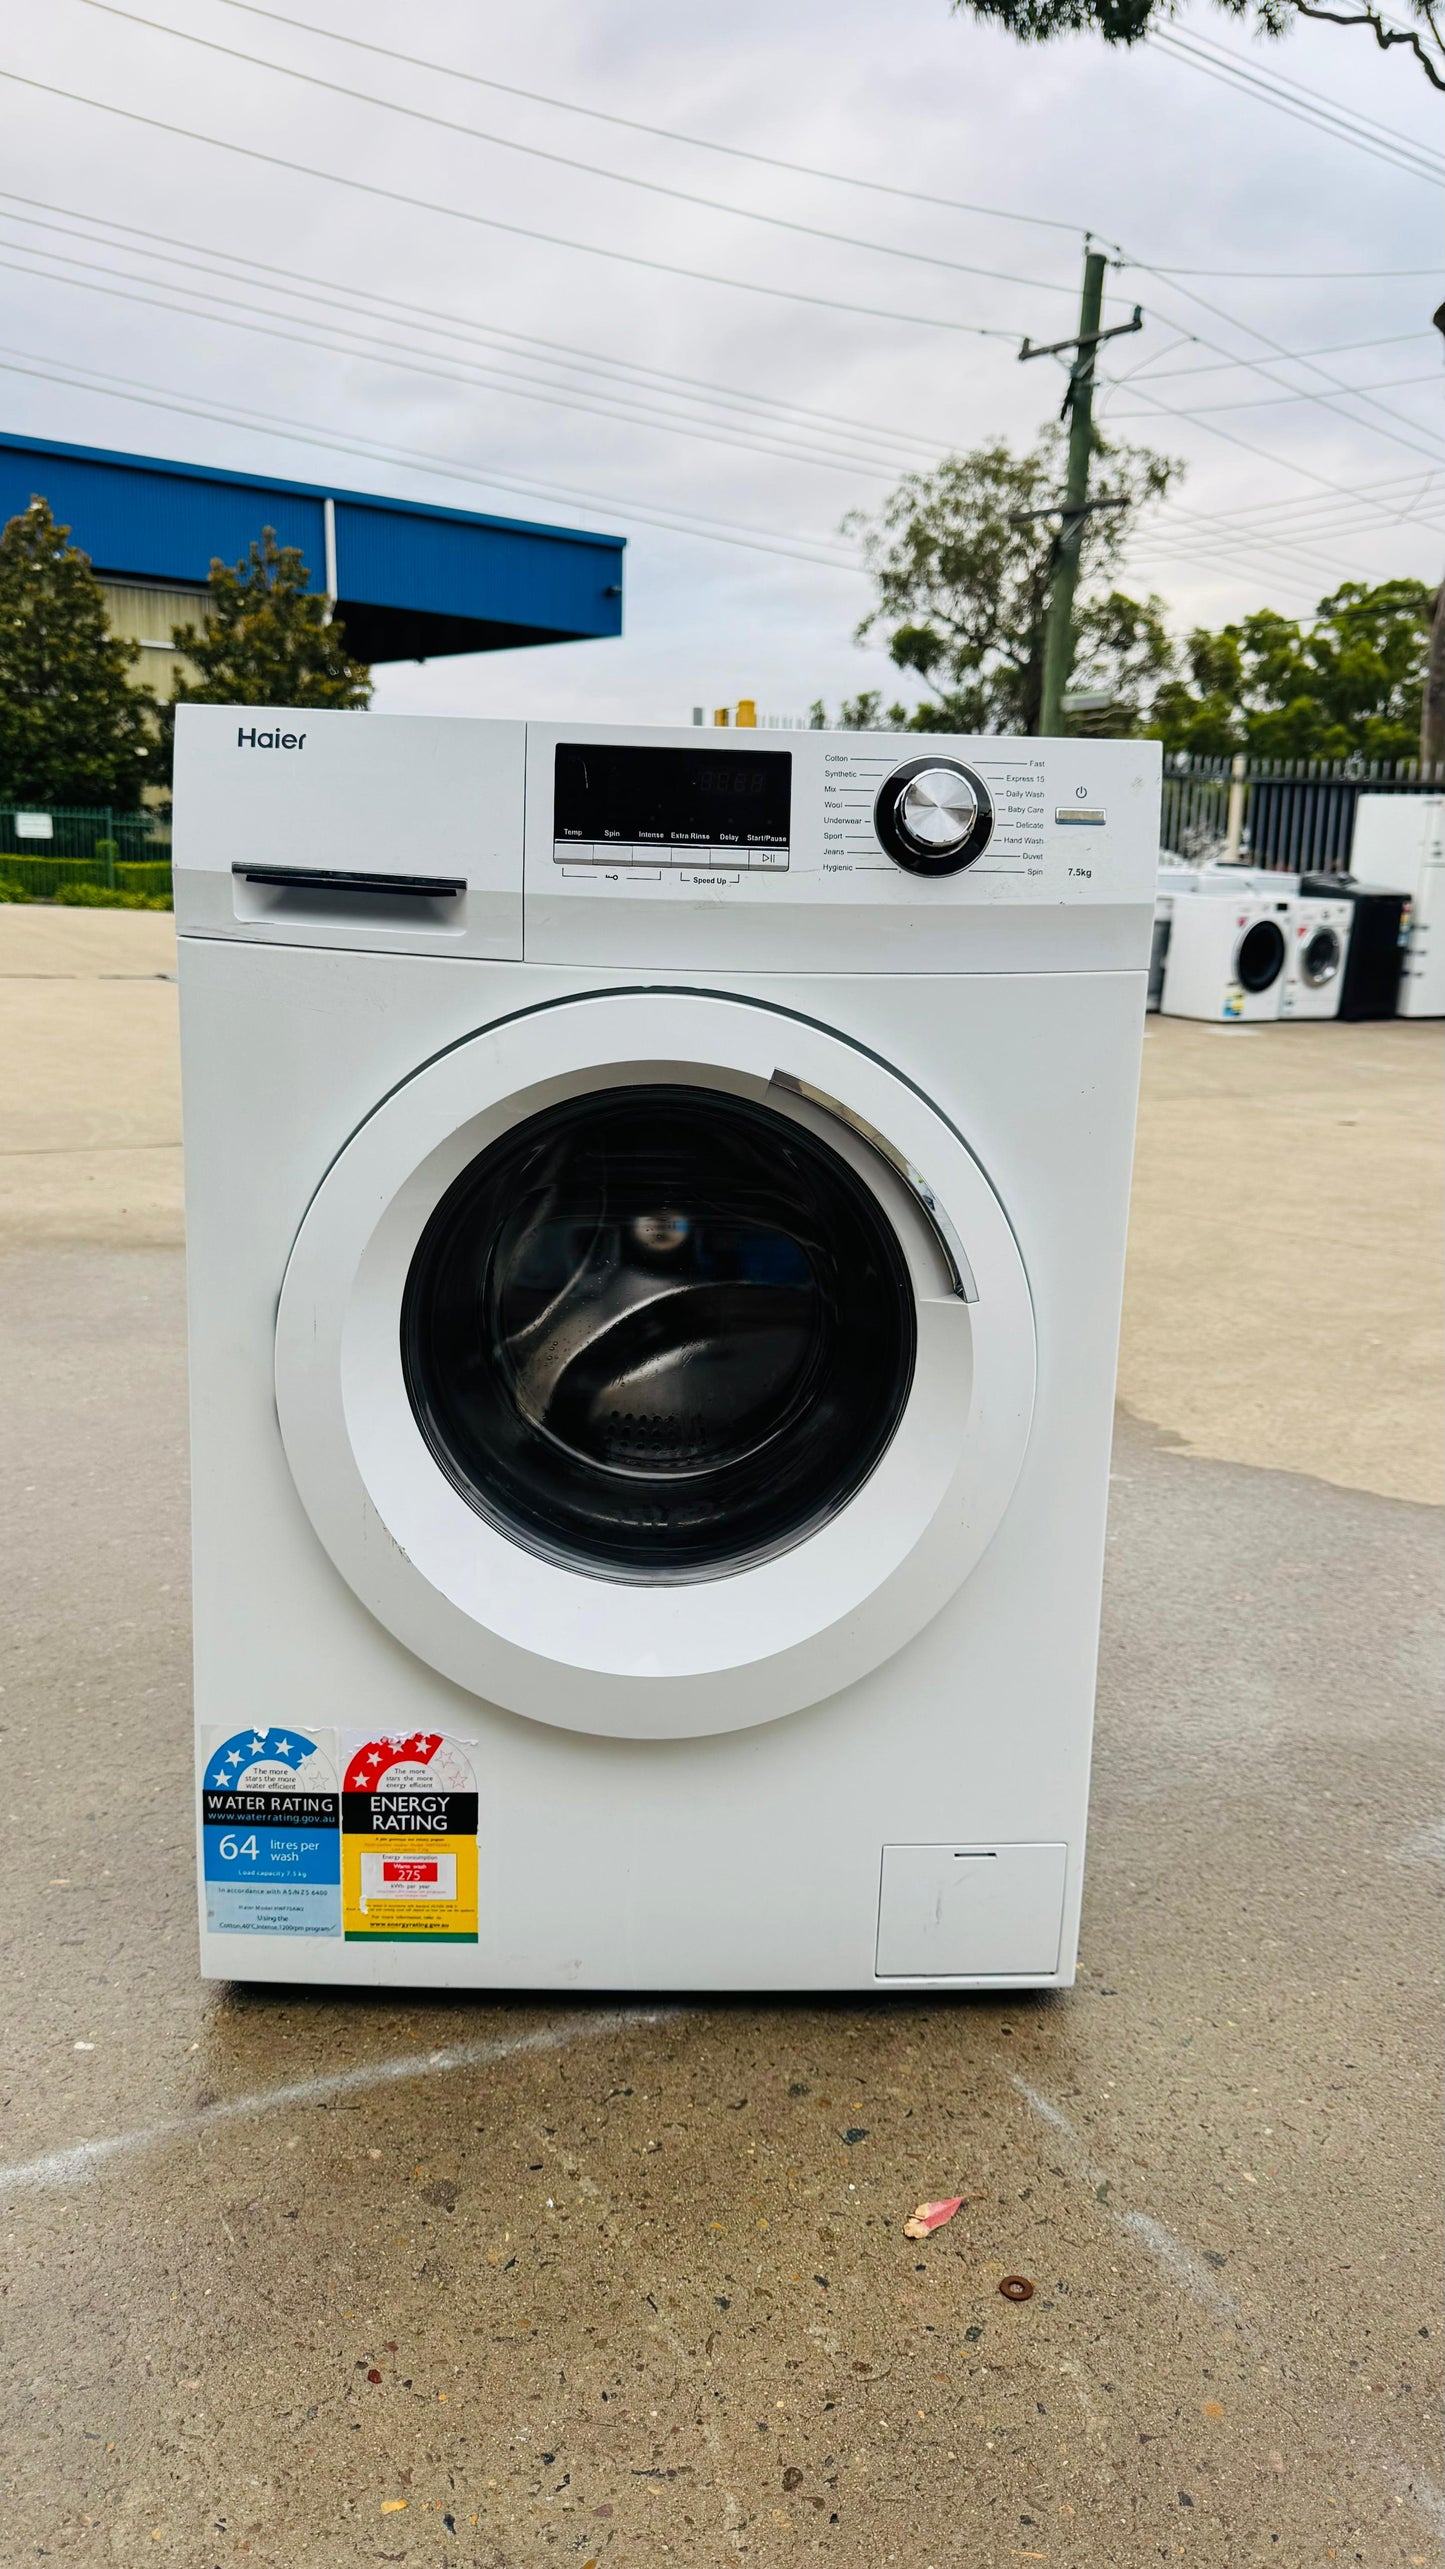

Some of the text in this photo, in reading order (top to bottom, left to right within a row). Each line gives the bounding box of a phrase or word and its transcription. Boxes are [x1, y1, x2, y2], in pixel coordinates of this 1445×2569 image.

[238, 727, 307, 749] Haier
[824, 754, 848, 762] Cotton
[1029, 760, 1045, 768] Fast
[824, 770, 857, 778] Synthetic
[1006, 774, 1034, 783] Express
[1005, 790, 1024, 799] Daily
[1007, 806, 1026, 814] Baby
[1015, 821, 1044, 829] Delicate
[564, 828, 583, 837] Temp
[604, 829, 620, 837] Spin
[638, 830, 664, 838] Intense
[670, 831, 711, 840] Extra Rinse
[823, 832, 843, 840] Sport
[719, 833, 739, 842] Delay
[747, 834, 787, 842] Start/Pause
[1024, 837, 1044, 845] Wash
[822, 864, 853, 872] Hygienic
[1027, 868, 1043, 877] Spin
[1067, 868, 1092, 879] 7.5kg
[693, 876, 727, 885] Speed Up
[253, 1767, 268, 1775] The
[268, 1782, 297, 1790] efficient
[208, 1795, 333, 1812] WATER RATING
[370, 1796, 450, 1812] ENERGY
[207, 1812, 335, 1824] www.waterrating.gov.au
[372, 1814, 448, 1831] RATING
[219, 1833, 320, 1861] 64 litres per
[270, 1851, 299, 1861] wash
[402, 1854, 438, 1862] consumption
[398, 1869, 421, 1881] 275
